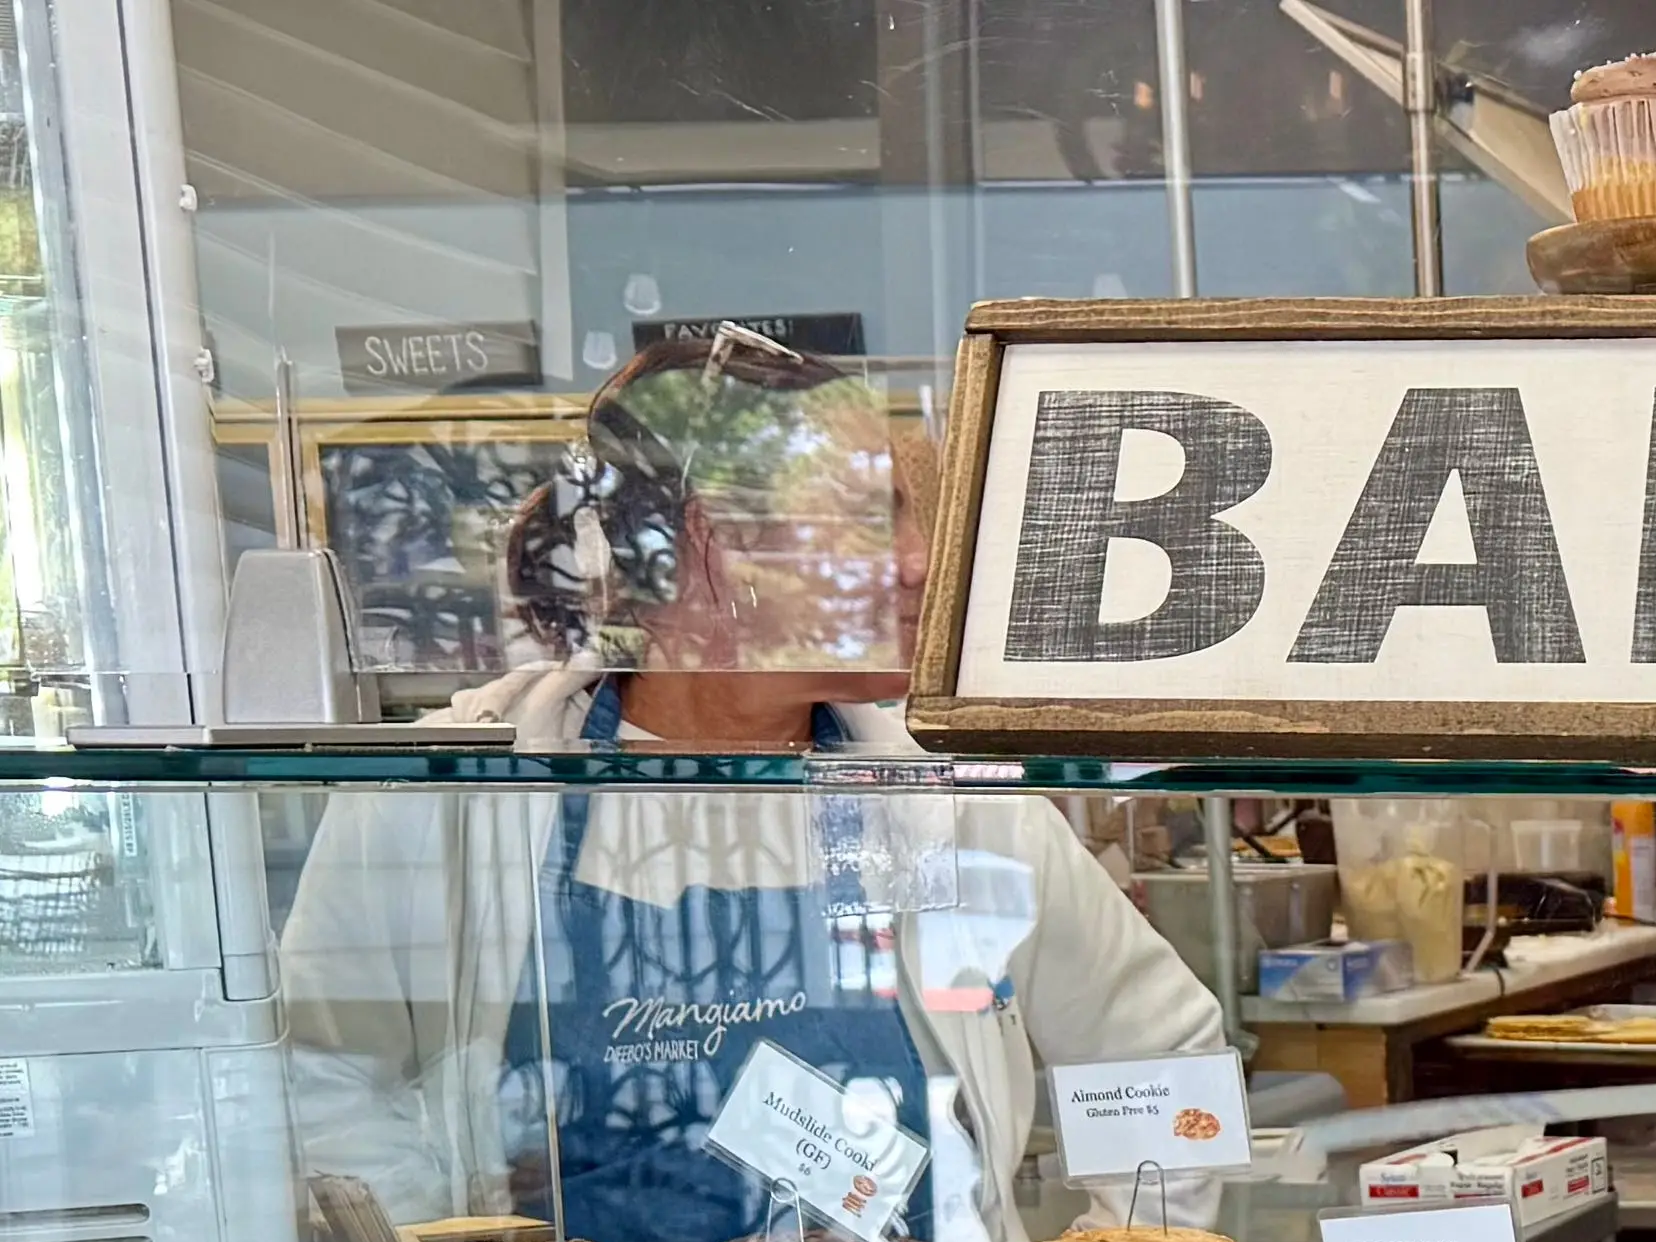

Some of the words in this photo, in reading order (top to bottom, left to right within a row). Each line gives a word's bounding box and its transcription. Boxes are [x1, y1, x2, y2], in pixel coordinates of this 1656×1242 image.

[364, 331, 489, 377] SWEETS
[602, 989, 806, 1056] Mangiamo
[654, 1040, 699, 1060] MARKET
[1071, 1087, 1122, 1103] Almond
[1125, 1084, 1170, 1099] Cookie
[763, 1092, 832, 1144] Mudslide
[1086, 1106, 1120, 1118] Gluten
[1122, 1105, 1144, 1116] Free
[795, 1138, 831, 1169] (GF)
